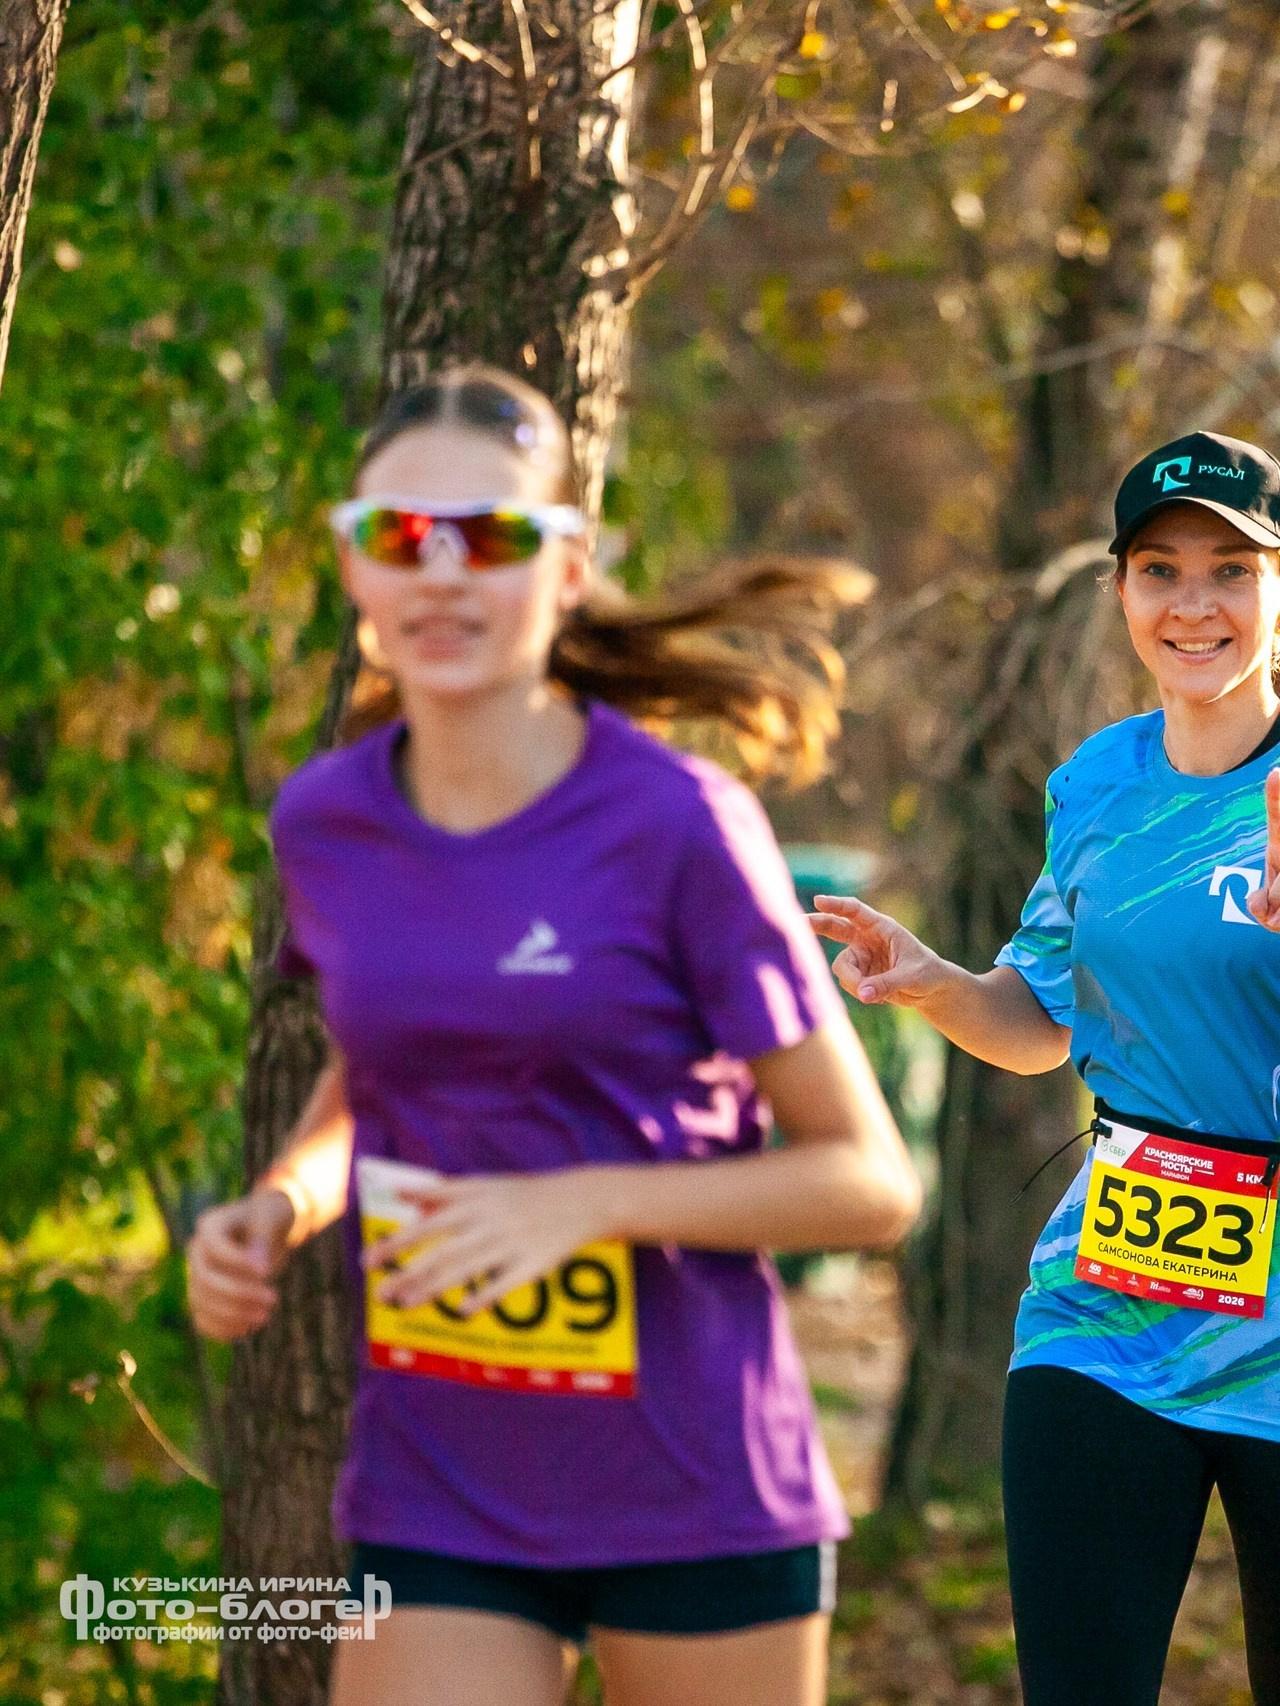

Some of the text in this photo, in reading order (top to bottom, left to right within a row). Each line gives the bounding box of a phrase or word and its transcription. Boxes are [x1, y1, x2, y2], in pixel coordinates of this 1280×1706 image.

[1198, 465, 1246, 481] РУСАЛ
[1109, 1145, 1127, 1158] СБЕР
[1144, 1147, 1214, 1170] КРАСНОЯРСКИЕ
[1160, 1161, 1193, 1174] МОСТЫ
[1160, 1170, 1190, 1182] МАРАФОН
[1236, 1172, 1245, 1182] 5
[1094, 1174, 1254, 1267] 5323
[1098, 1242, 1238, 1283] САМСОНОВА ЕКАТЕРИНА
[1218, 1294, 1245, 1307] 2026
